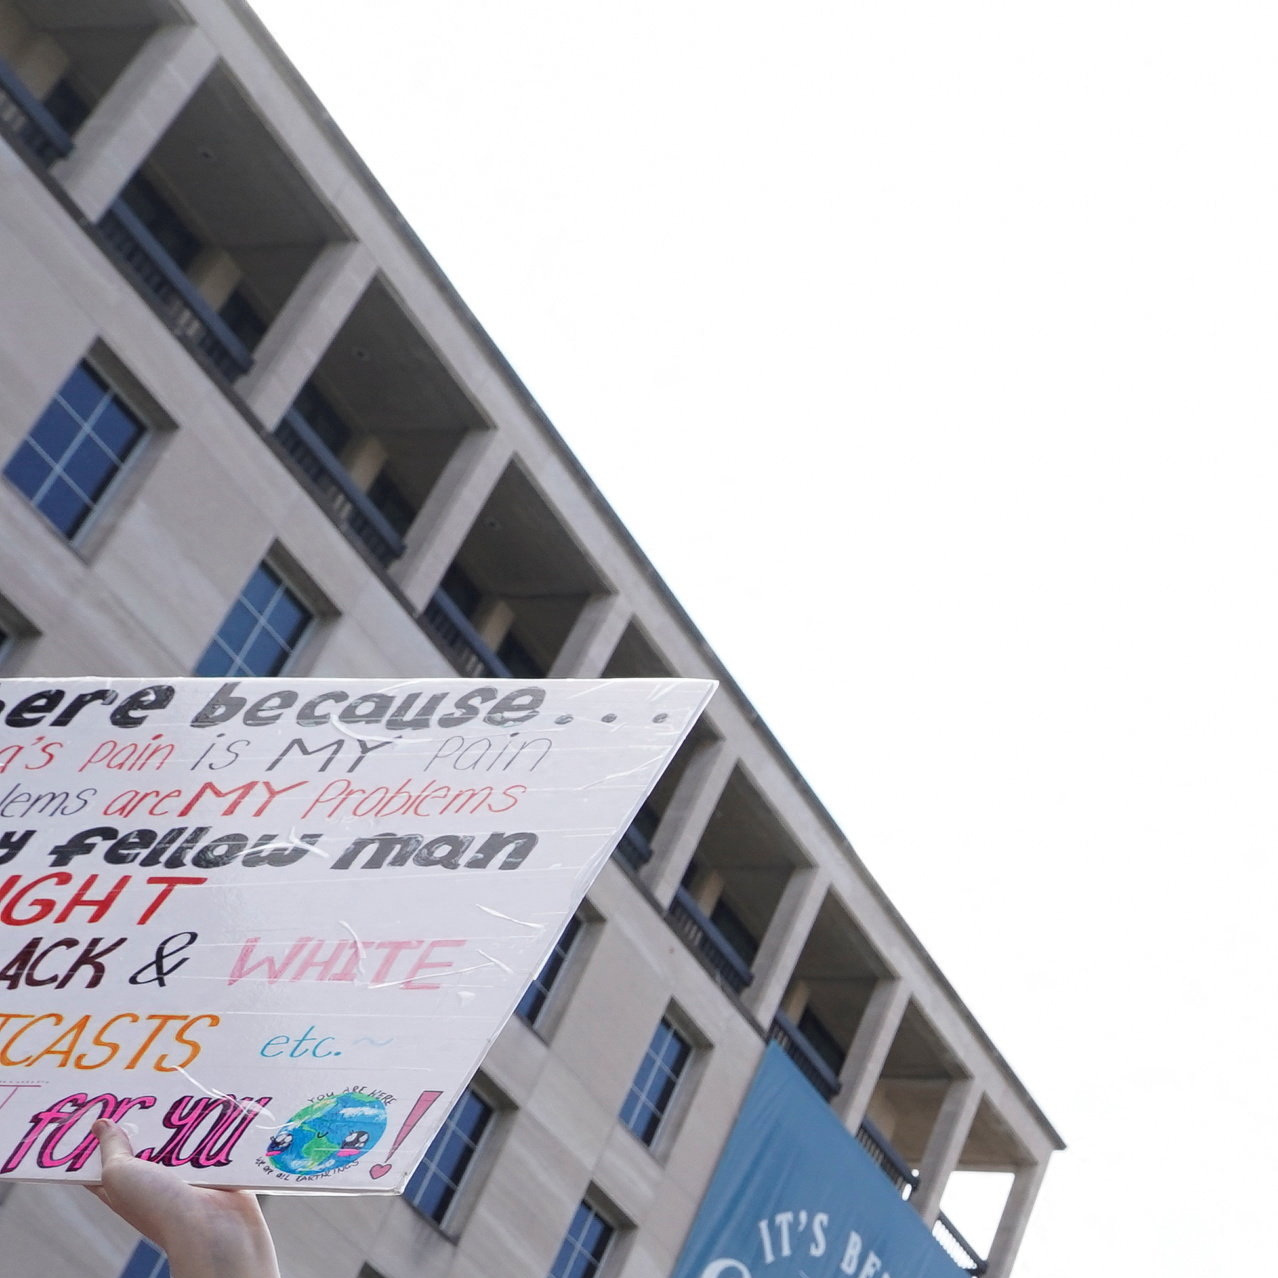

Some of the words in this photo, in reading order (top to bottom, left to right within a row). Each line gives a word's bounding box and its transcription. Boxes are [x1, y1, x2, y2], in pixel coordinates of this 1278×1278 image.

[0, 683, 175, 728] ere
[78, 733, 175, 773] pain
[190, 733, 251, 771] is
[266, 737, 403, 773] MY
[102, 789, 182, 818] are
[177, 780, 308, 818] MY
[47, 826, 322, 870] fellow
[330, 832, 540, 870] man
[128, 931, 199, 988] &
[227, 936, 466, 991] WHITE
[370, 1089, 398, 1106] HERE
[759, 1209, 829, 1264] IT'S
